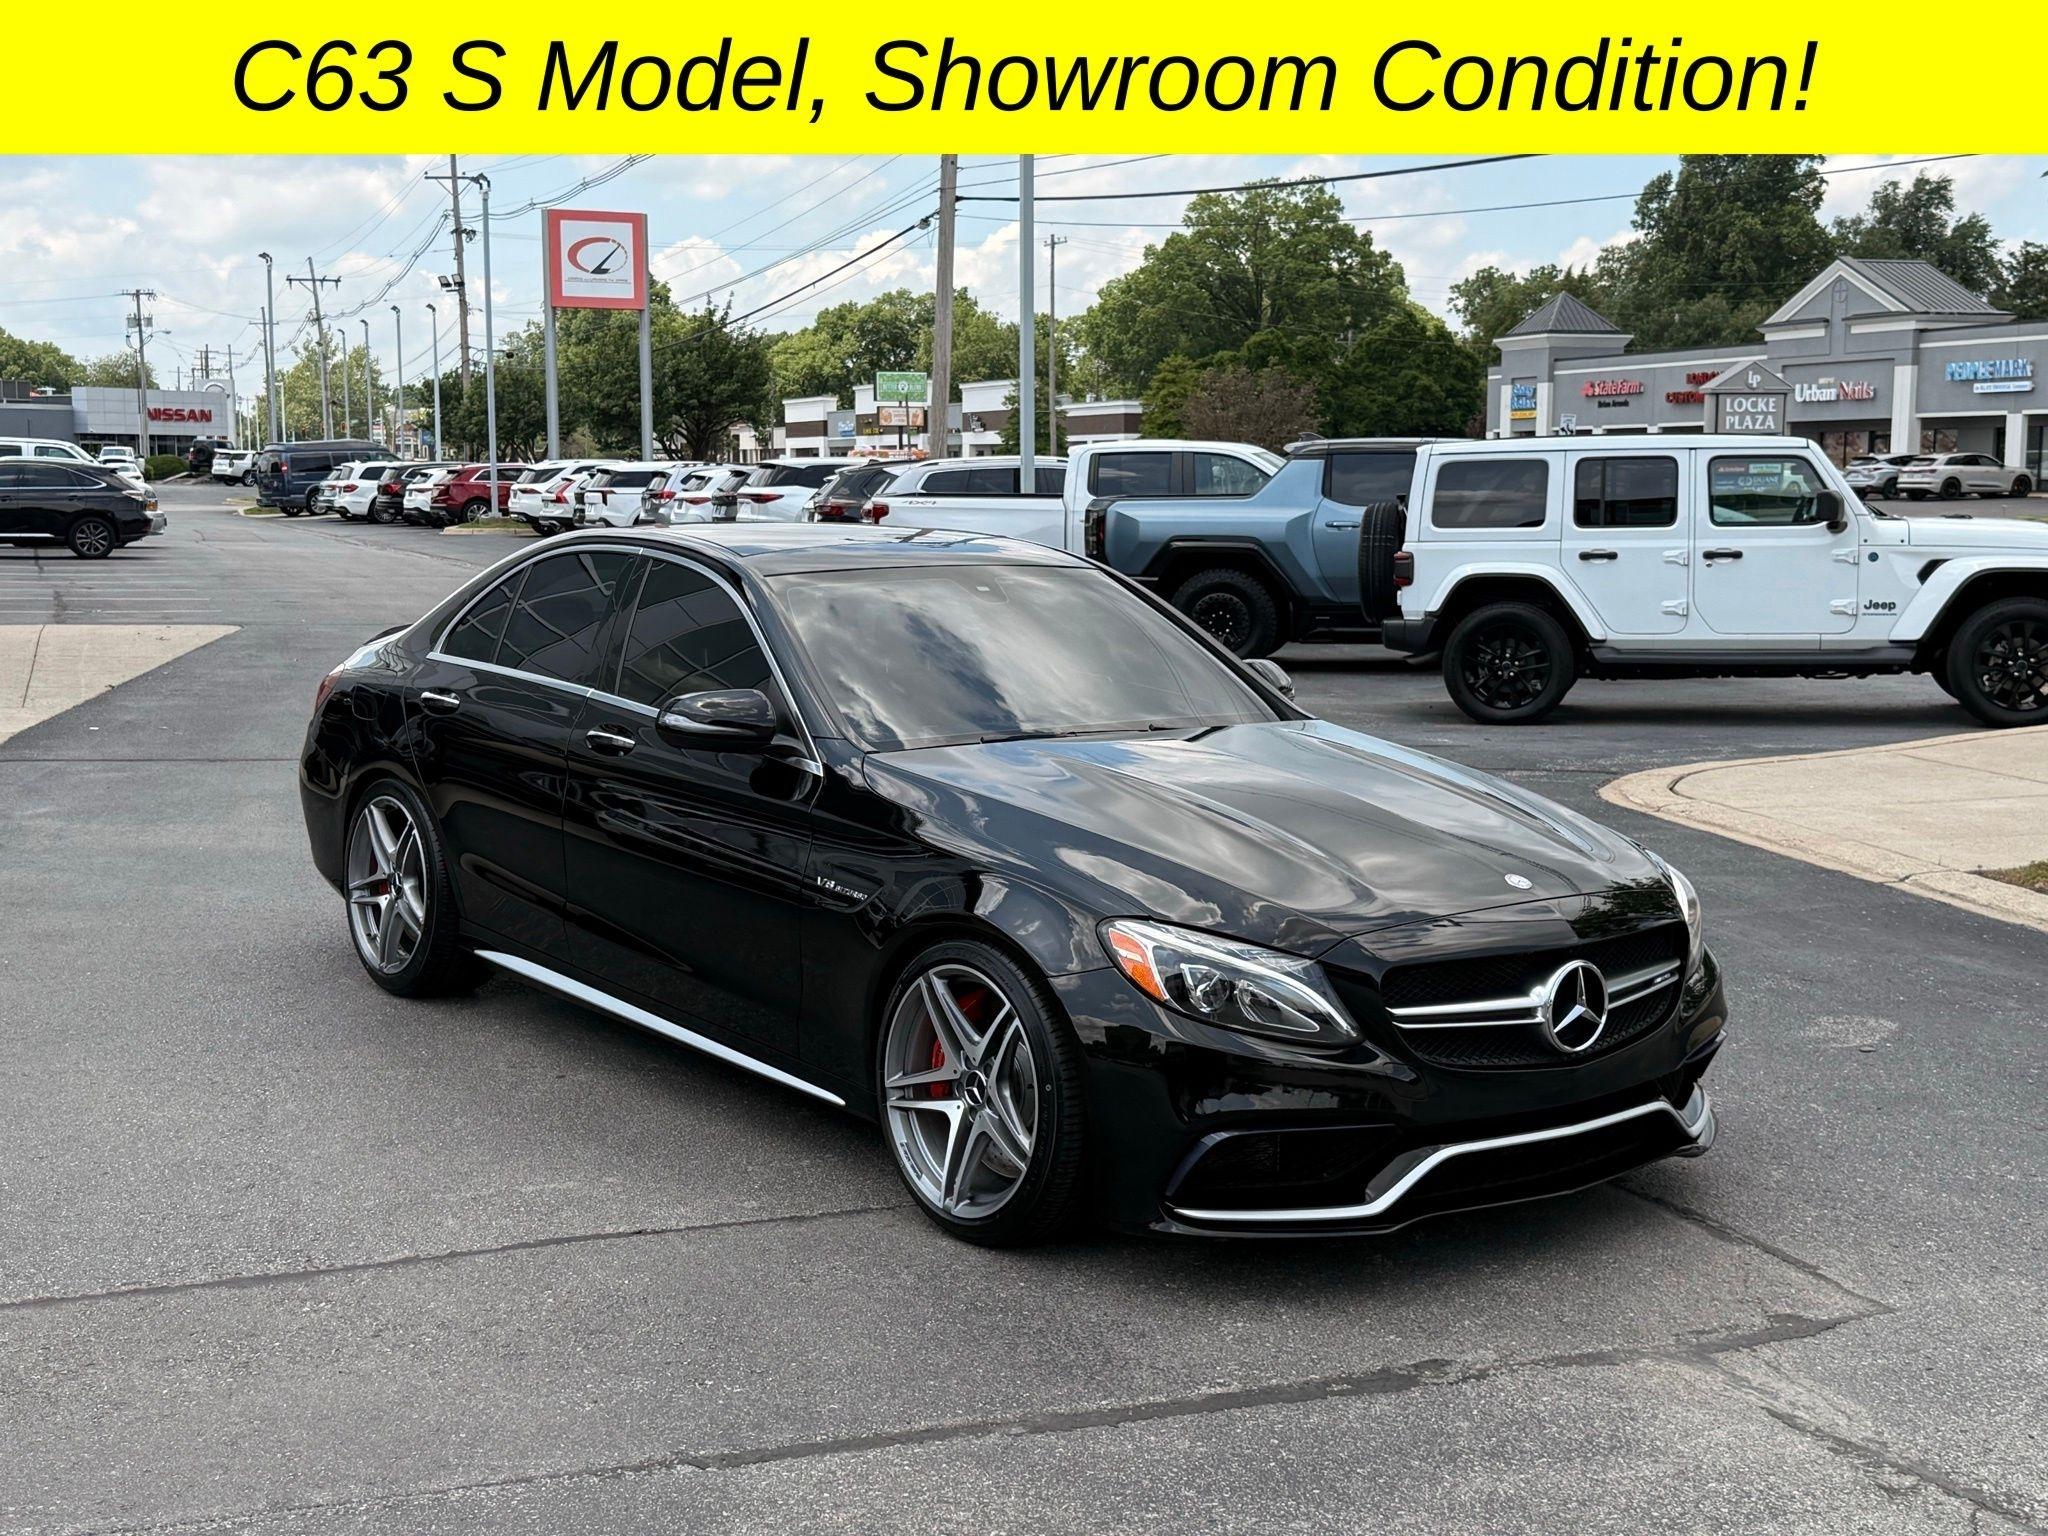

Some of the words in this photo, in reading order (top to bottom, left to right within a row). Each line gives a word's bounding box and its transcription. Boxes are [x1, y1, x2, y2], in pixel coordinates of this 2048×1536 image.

[1795, 384, 1837, 402] Urban
[1840, 380, 1875, 400] Nails
[1725, 397, 1777, 412] LOCKE
[147, 408, 212, 422] NISSAN
[1725, 415, 1775, 430] PLAZA
[1863, 599, 1897, 612] Jeep
[817, 875, 836, 889] V8
